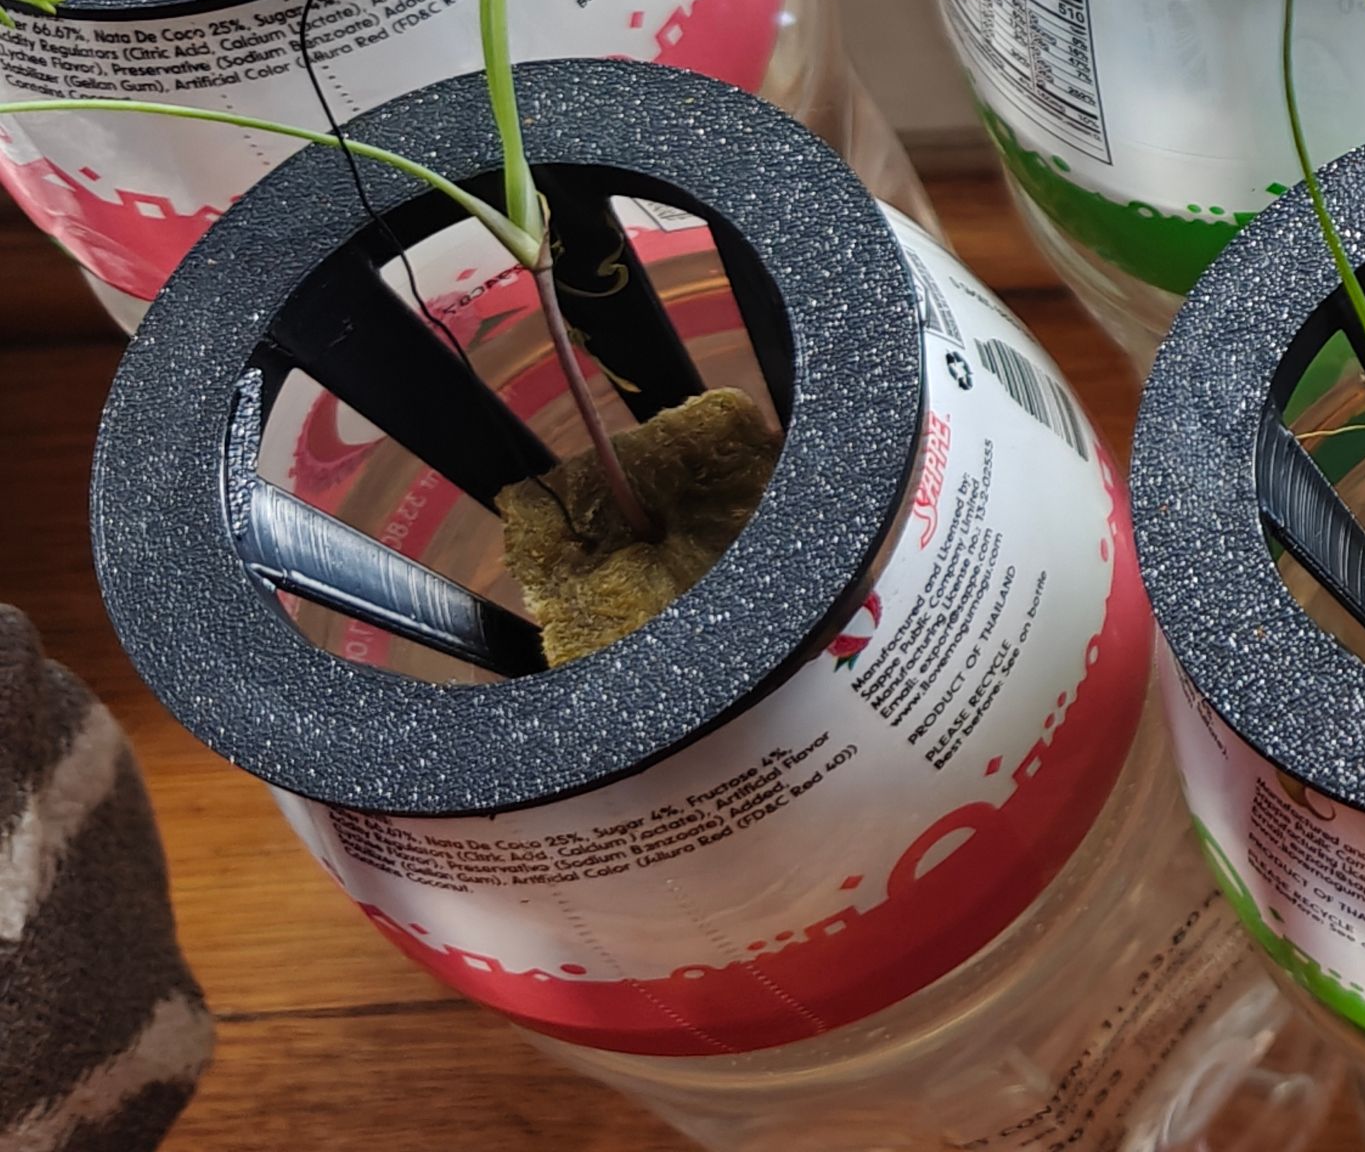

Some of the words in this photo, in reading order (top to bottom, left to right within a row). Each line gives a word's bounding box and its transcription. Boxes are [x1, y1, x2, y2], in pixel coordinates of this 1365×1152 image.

[1058, 2, 1086, 23] 510
[851, 594, 926, 693] Manufactured
[924, 562, 942, 596] and
[939, 503, 963, 564] Licensed
[860, 655, 901, 702] Sappe
[899, 611, 931, 655] Public
[929, 536, 968, 611] Company
[870, 611, 950, 712] Manufacturing
[943, 559, 971, 618] License
[907, 674, 966, 746] PRODUCT
[966, 646, 982, 671] OF
[979, 564, 1016, 645] THAILAND
[918, 527, 994, 675] export@sappe.com
[925, 709, 970, 763] PLEASE
[969, 639, 1013, 710] RECYCLE
[934, 736, 963, 771] Best
[591, 816, 646, 839] Sugar
[686, 765, 760, 808] Fructose
